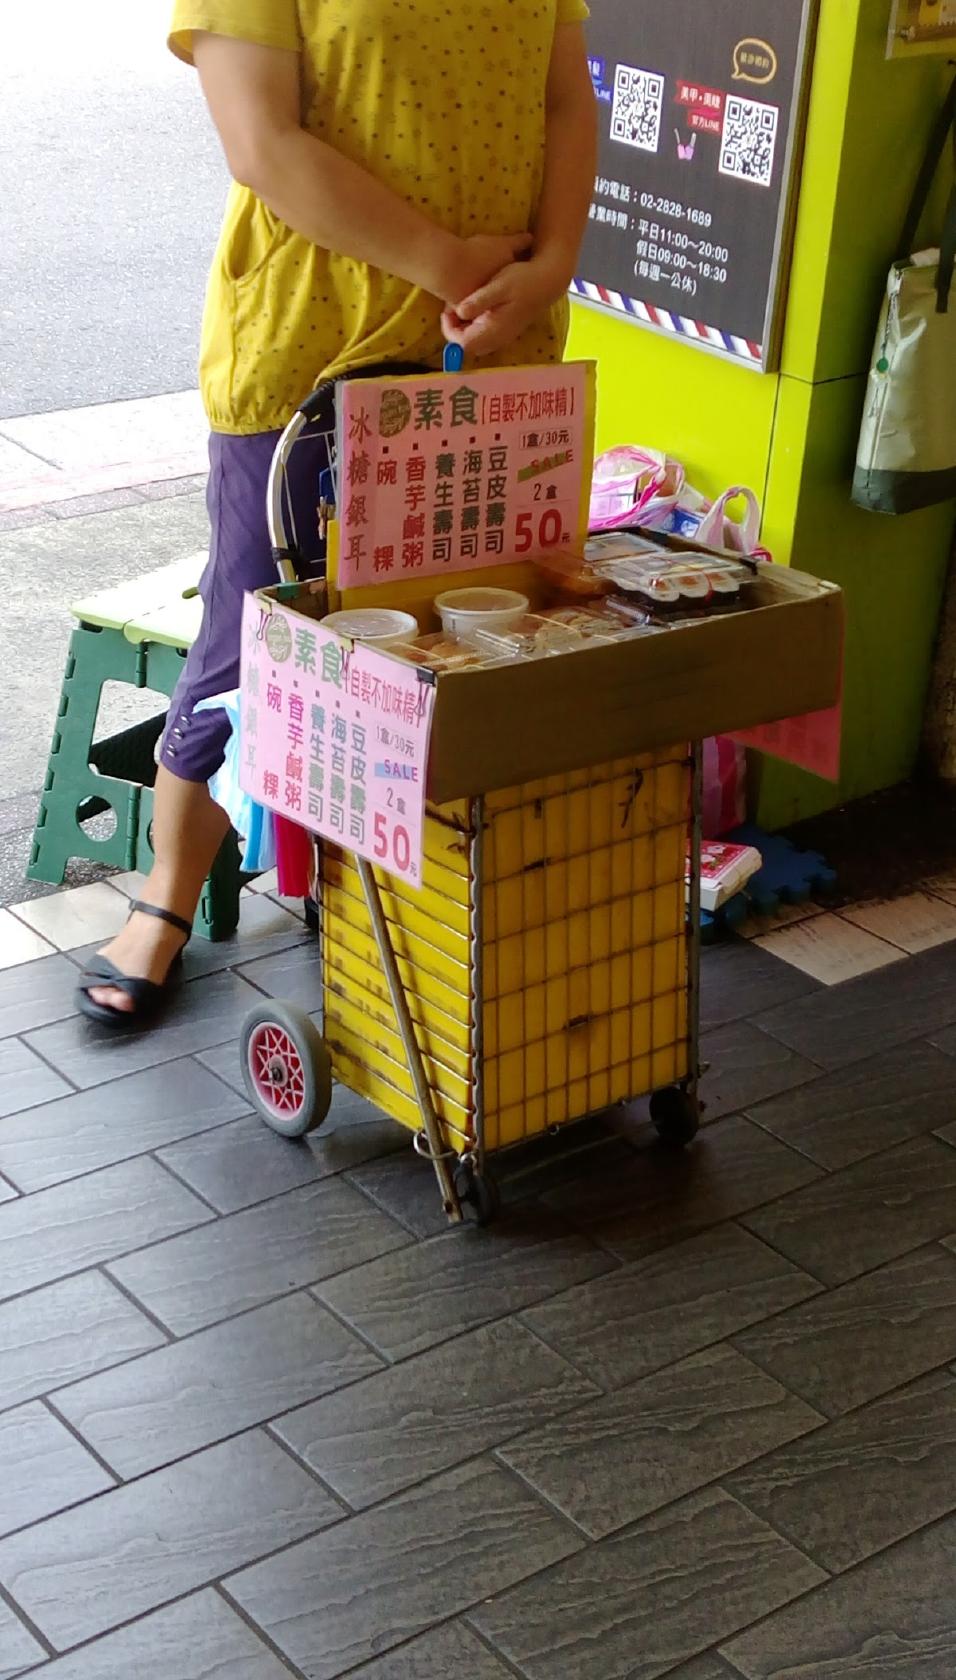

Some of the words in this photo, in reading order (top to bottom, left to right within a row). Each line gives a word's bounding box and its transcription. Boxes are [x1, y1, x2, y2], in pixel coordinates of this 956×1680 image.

[413, 385, 479, 431] 素食
[530, 449, 574, 472] SALE
[401, 456, 426, 568] 香芋鹹粥
[432, 453, 456, 562] 養生壽司
[459, 449, 484, 558] 海苔壽司
[485, 445, 509, 554] 豆皮壽司
[294, 627, 343, 689] 素食
[329, 712, 348, 836] 海苔壽司
[349, 721, 367, 846] 豆皮壽司
[383, 758, 419, 783] SALE
